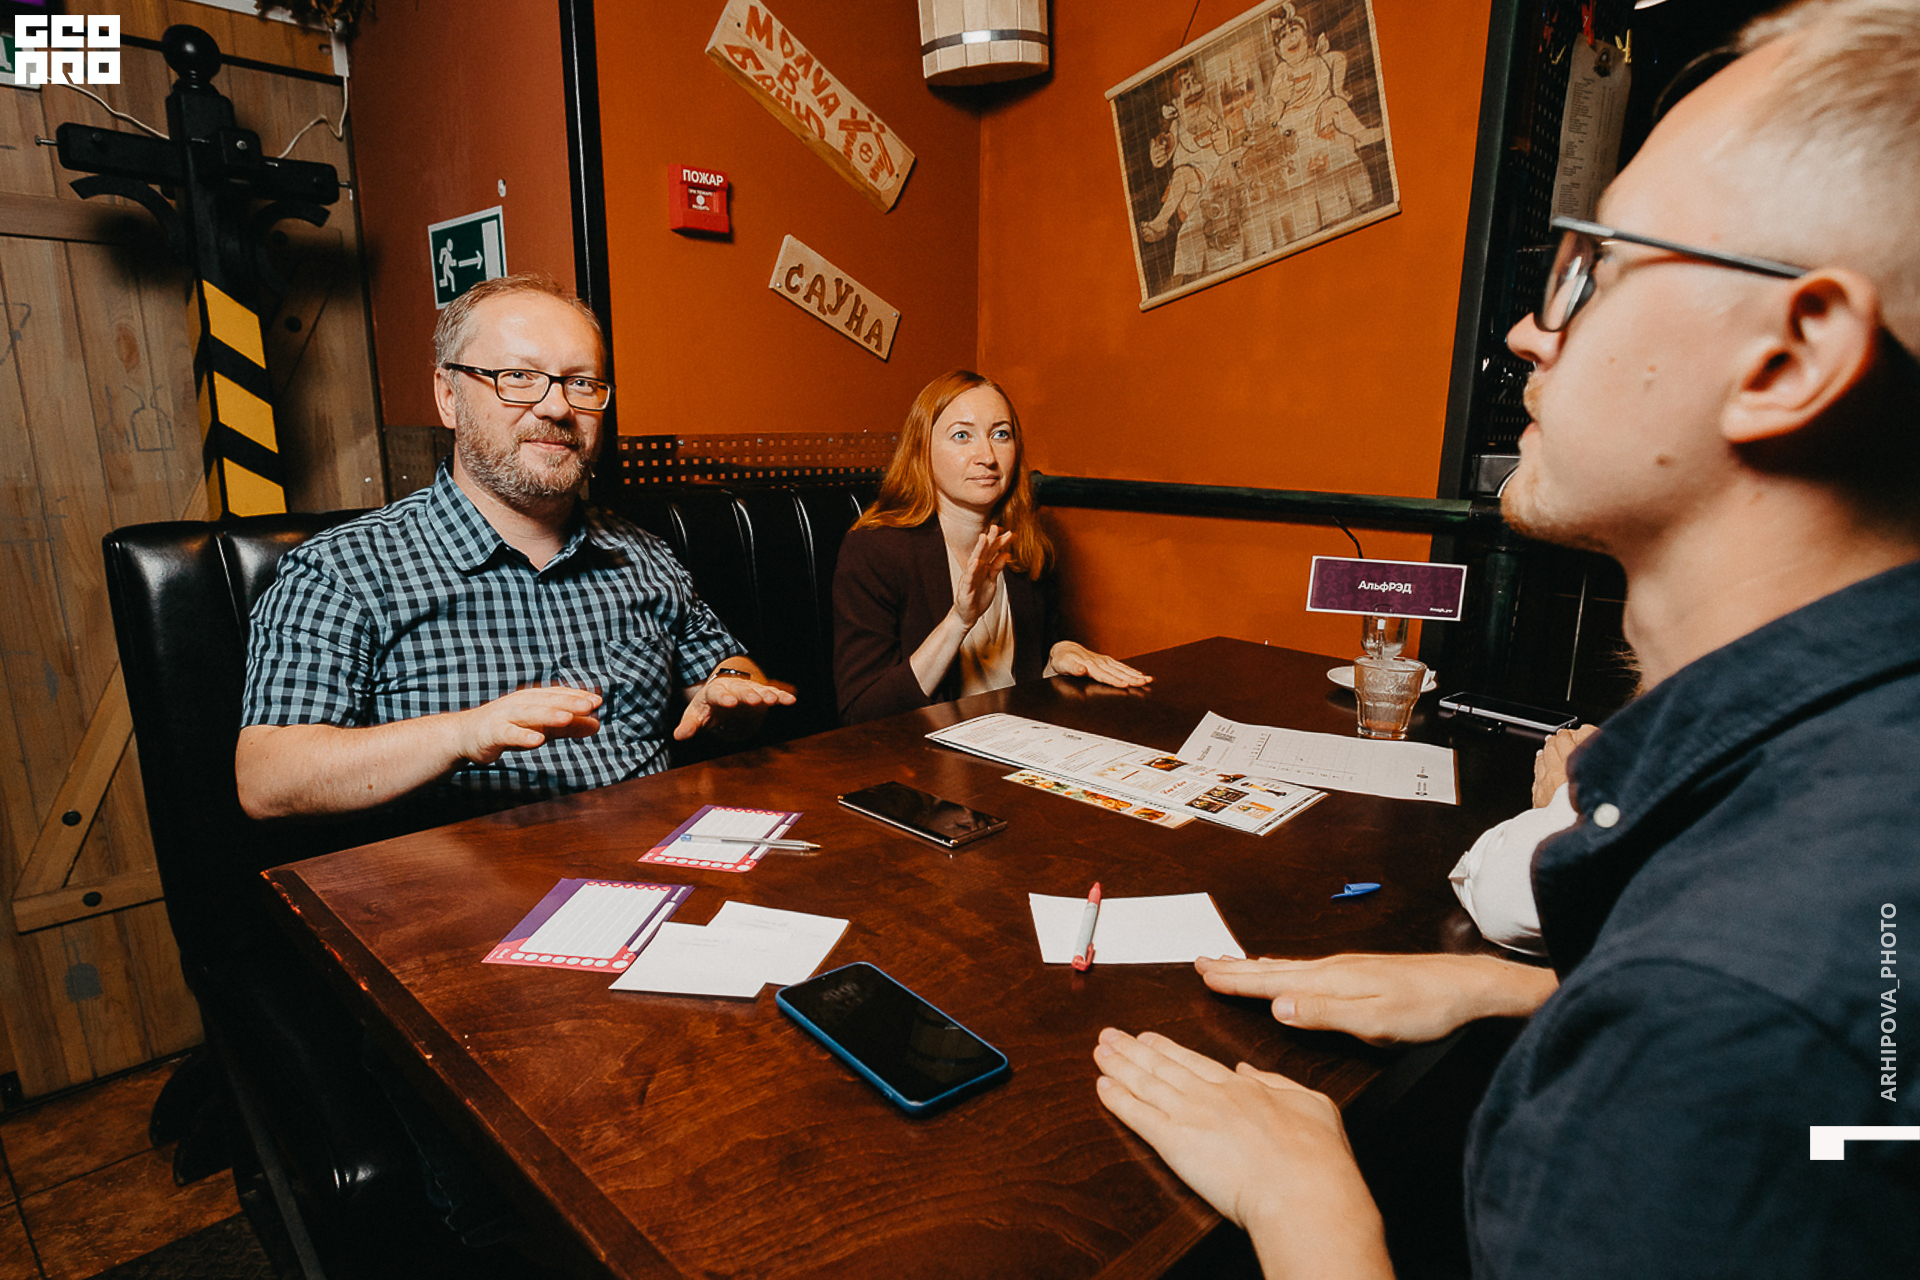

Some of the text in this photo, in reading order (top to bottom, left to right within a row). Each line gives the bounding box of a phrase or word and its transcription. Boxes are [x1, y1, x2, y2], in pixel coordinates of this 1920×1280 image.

[724, 43, 826, 139] БАНЮ
[777, 62, 800, 96] В
[683, 169, 724, 186] ПОЖАР
[784, 263, 884, 352] САУНА
[1358, 580, 1413, 594] АльфРЭД
